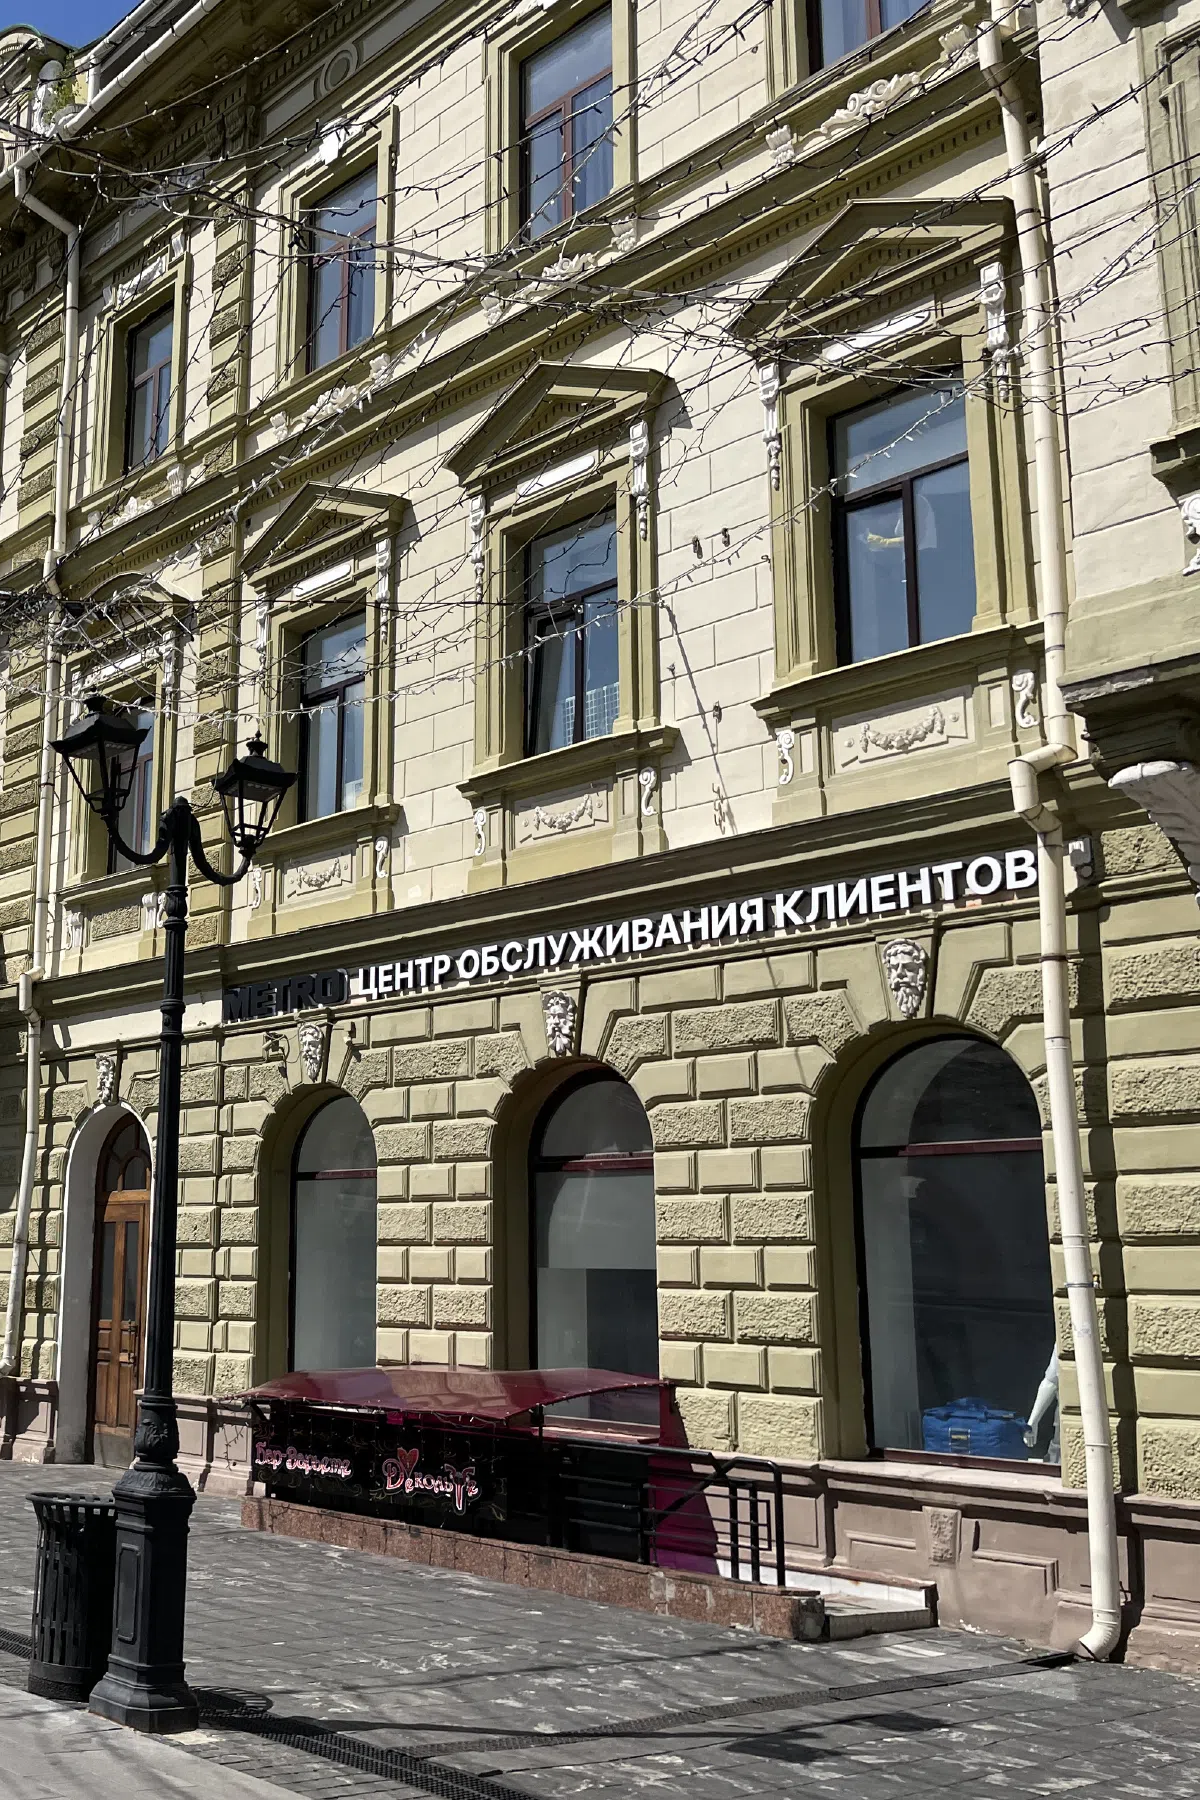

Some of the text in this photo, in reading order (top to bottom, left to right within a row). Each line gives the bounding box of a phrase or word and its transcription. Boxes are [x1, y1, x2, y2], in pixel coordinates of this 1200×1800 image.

[222, 849, 1039, 1024] METRO ЦЕНТР ОБСЛУЖИВАНИЯ КЛИЕНТОВ
